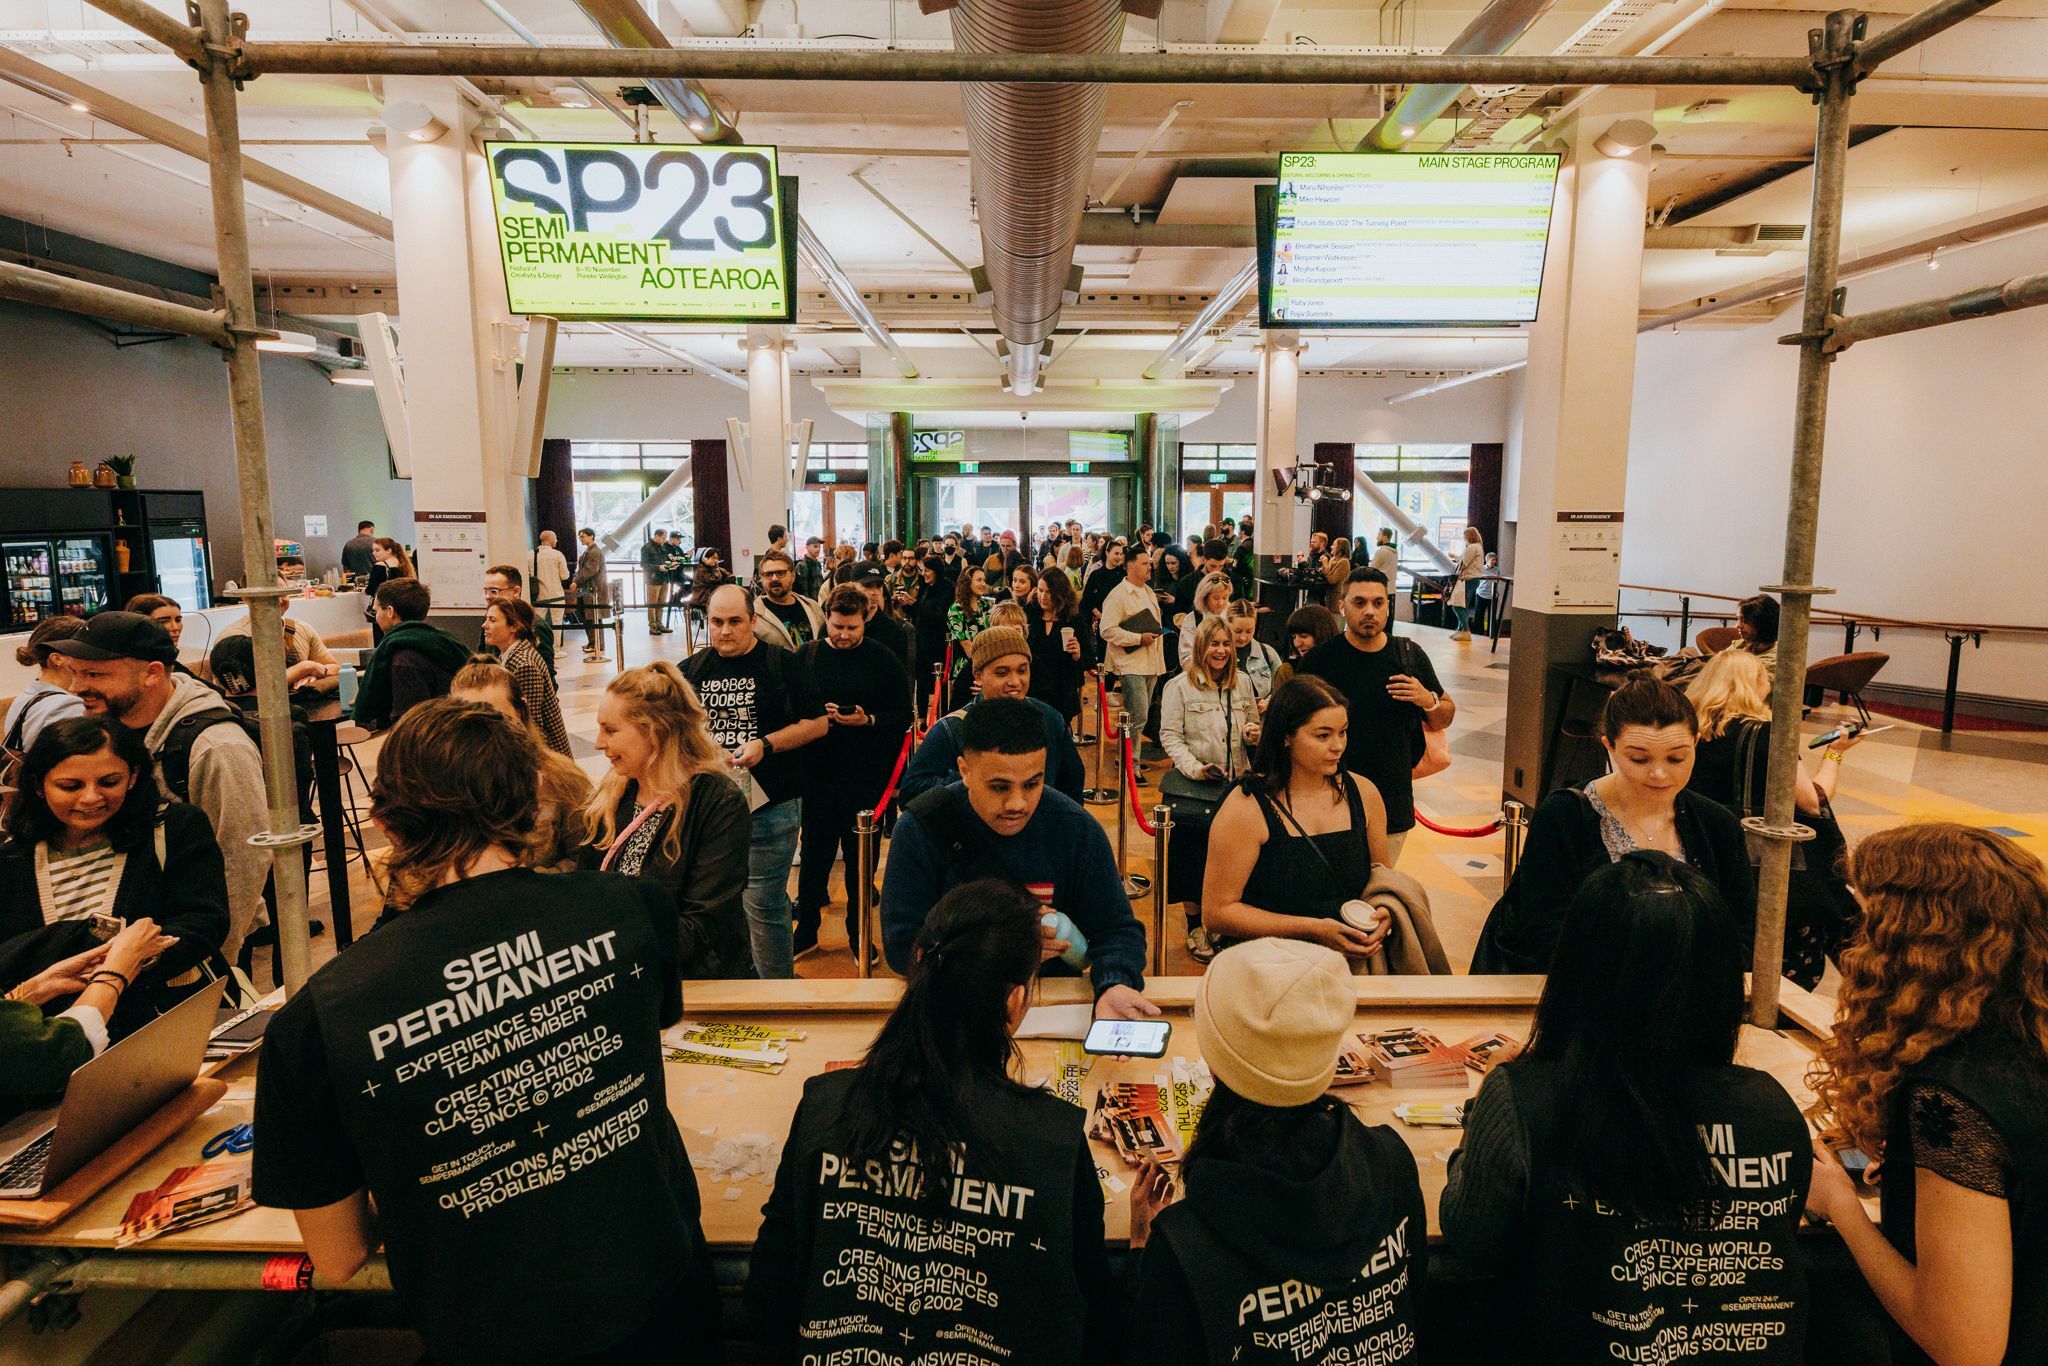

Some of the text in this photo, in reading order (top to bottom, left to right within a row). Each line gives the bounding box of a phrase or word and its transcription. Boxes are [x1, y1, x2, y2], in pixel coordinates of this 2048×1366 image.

[1284, 156, 1317, 168] SP23:
[1418, 157, 1556, 169] MAIN STAGE PROGRAM
[493, 148, 777, 252] SP23
[503, 216, 565, 240] SEMI
[1366, 219, 1389, 228] Turning
[507, 241, 667, 265] PERMANENT
[640, 267, 780, 291] AOTEAROA
[700, 691, 756, 706] YOOBEE
[442, 929, 544, 992] SEMI
[368, 931, 617, 1061] PERMANENT
[395, 973, 616, 1084] EXPERIENCE SUPPORT
[441, 1004, 588, 1080] TEAM MEMBER
[705, 1027, 741, 1037] SP23:
[744, 1030, 771, 1039] THU
[434, 1025, 608, 1115] CREATING WORLD
[1067, 1064, 1079, 1078] FRI
[424, 1034, 624, 1137] CLASS EXPERIENCES
[576, 1072, 646, 1119] @SEMIPERMANENT
[594, 1074, 633, 1102] OPEN 24/7
[471, 1066, 596, 1136] SINCE © 2002
[1174, 1082, 1191, 1132] SP23: THU
[419, 1139, 517, 1185] SEMIPERMANENT.COM
[431, 1141, 496, 1174] GET IN TOUCH
[438, 1098, 650, 1211] QUESTIONS ANSWERED
[462, 1122, 642, 1220] PROBLEMS SOLVED
[822, 1202, 1015, 1248] EXPERIENCE SUPPORT
[856, 1220, 976, 1258] TEAM MEMBER
[1624, 1238, 1772, 1264] CREATING WORLD
[838, 1249, 988, 1287] CREATING WORLD
[1611, 1255, 1784, 1282] CLASS EXPERIENCES
[1642, 1271, 1687, 1292] SINCE
[1709, 1271, 1746, 1287] 2002
[823, 1267, 999, 1308] CLASS EXPERIENCES
[856, 1283, 905, 1313] SINCE
[923, 1295, 964, 1312] 2002
[1739, 1295, 1762, 1303] OPEN
[1607, 1309, 1627, 1322] GET
[1629, 1313, 1639, 1323] IN
[1721, 1301, 1795, 1312] @SEMIPERMANENT
[800, 1323, 883, 1340] EMIPERMANENT.COM
[809, 1314, 868, 1330] GET IN TOUCH
[954, 1323, 978, 1337] OPEN
[1291, 1326, 1328, 1362] TEAM
[1327, 1301, 1394, 1334] MEMBER
[1692, 1321, 1786, 1340] ANSWERED
[936, 1329, 1012, 1357] @SEMIPERMANENT
[1354, 1323, 1407, 1358] WORLD
[1702, 1337, 1768, 1352] SOLVED
